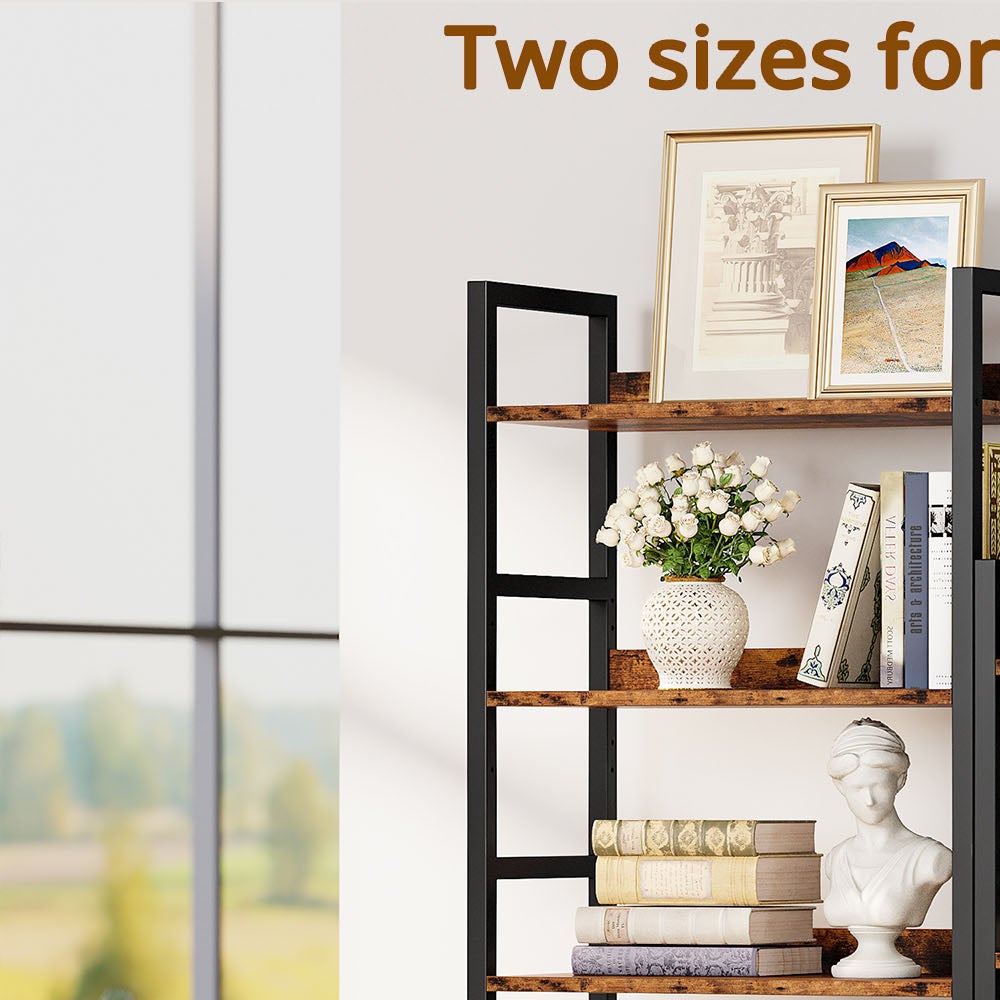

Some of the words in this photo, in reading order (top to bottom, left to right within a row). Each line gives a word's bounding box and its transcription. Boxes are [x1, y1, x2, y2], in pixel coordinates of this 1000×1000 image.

[908, 525, 922, 593] architecture
[911, 598, 922, 606] &
[909, 612, 922, 634] arts
